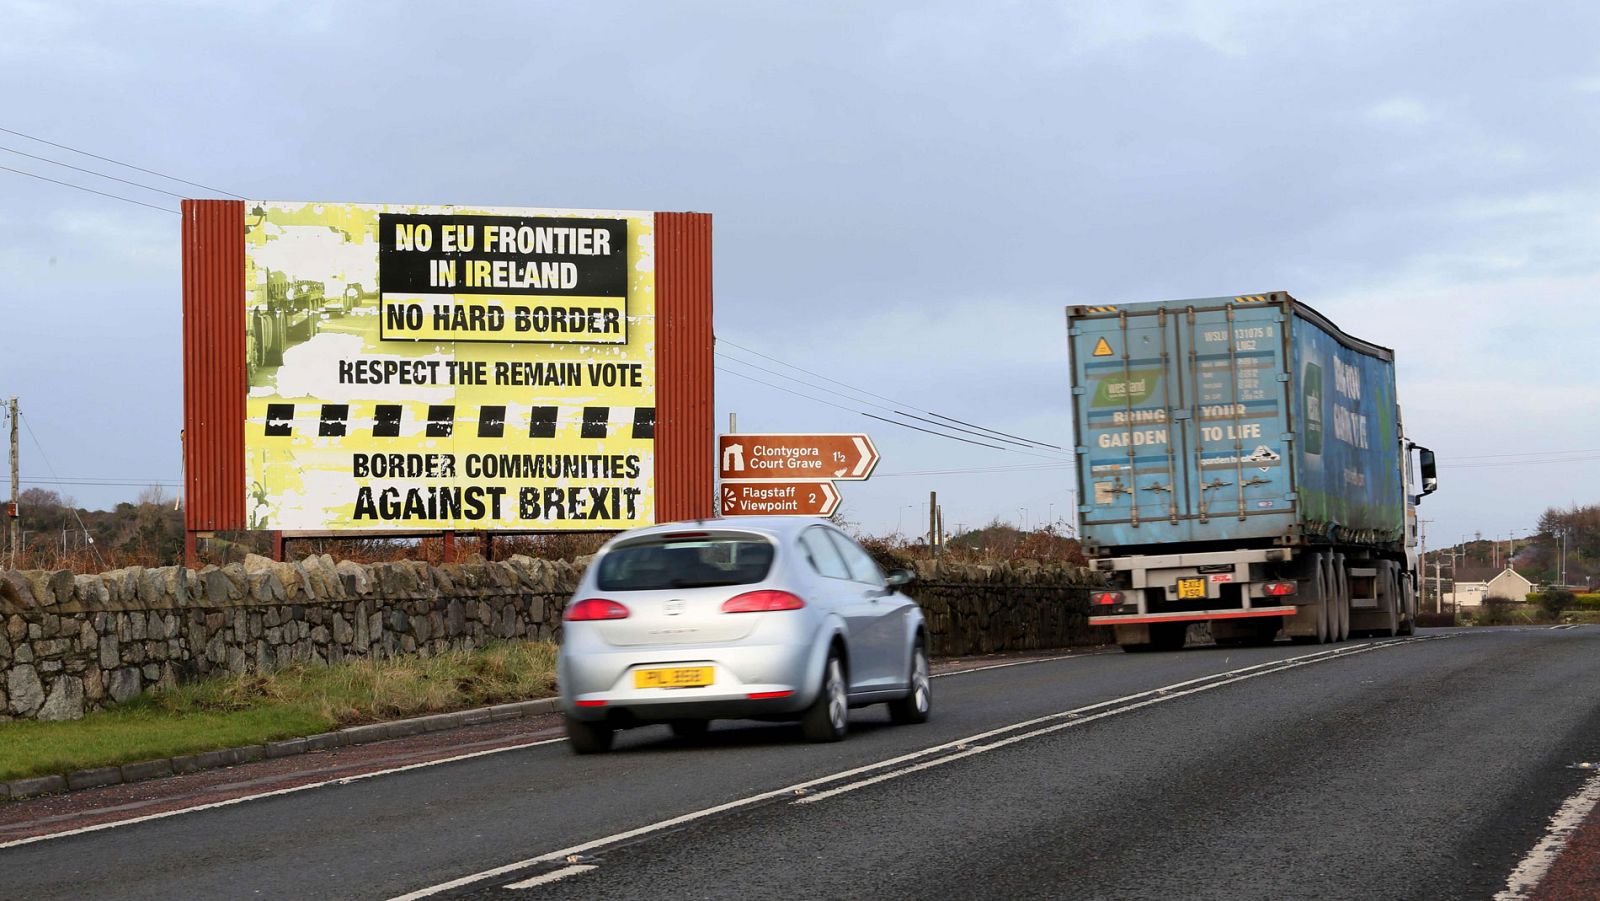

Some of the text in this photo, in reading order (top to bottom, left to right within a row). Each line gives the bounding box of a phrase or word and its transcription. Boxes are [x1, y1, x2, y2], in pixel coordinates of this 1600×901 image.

[395, 223, 611, 256] NO EU FRONTIER
[429, 259, 578, 289] IN IRELAND
[387, 303, 620, 333] NO HARD BORDER
[339, 359, 643, 388] RESPECT THE REMAIN VOTE
[1201, 403, 1247, 417] YOUR
[1098, 423, 1261, 448] GARDEN TO LIFE
[750, 458, 822, 469] Court Grave
[753, 445, 819, 458] Clontygora
[353, 453, 641, 479] BORDER COMMUNITIES
[353, 486, 641, 521] AGAINST BREXIT
[740, 500, 798, 512] Viewpoint
[743, 486, 816, 504] Flagstaff 2
